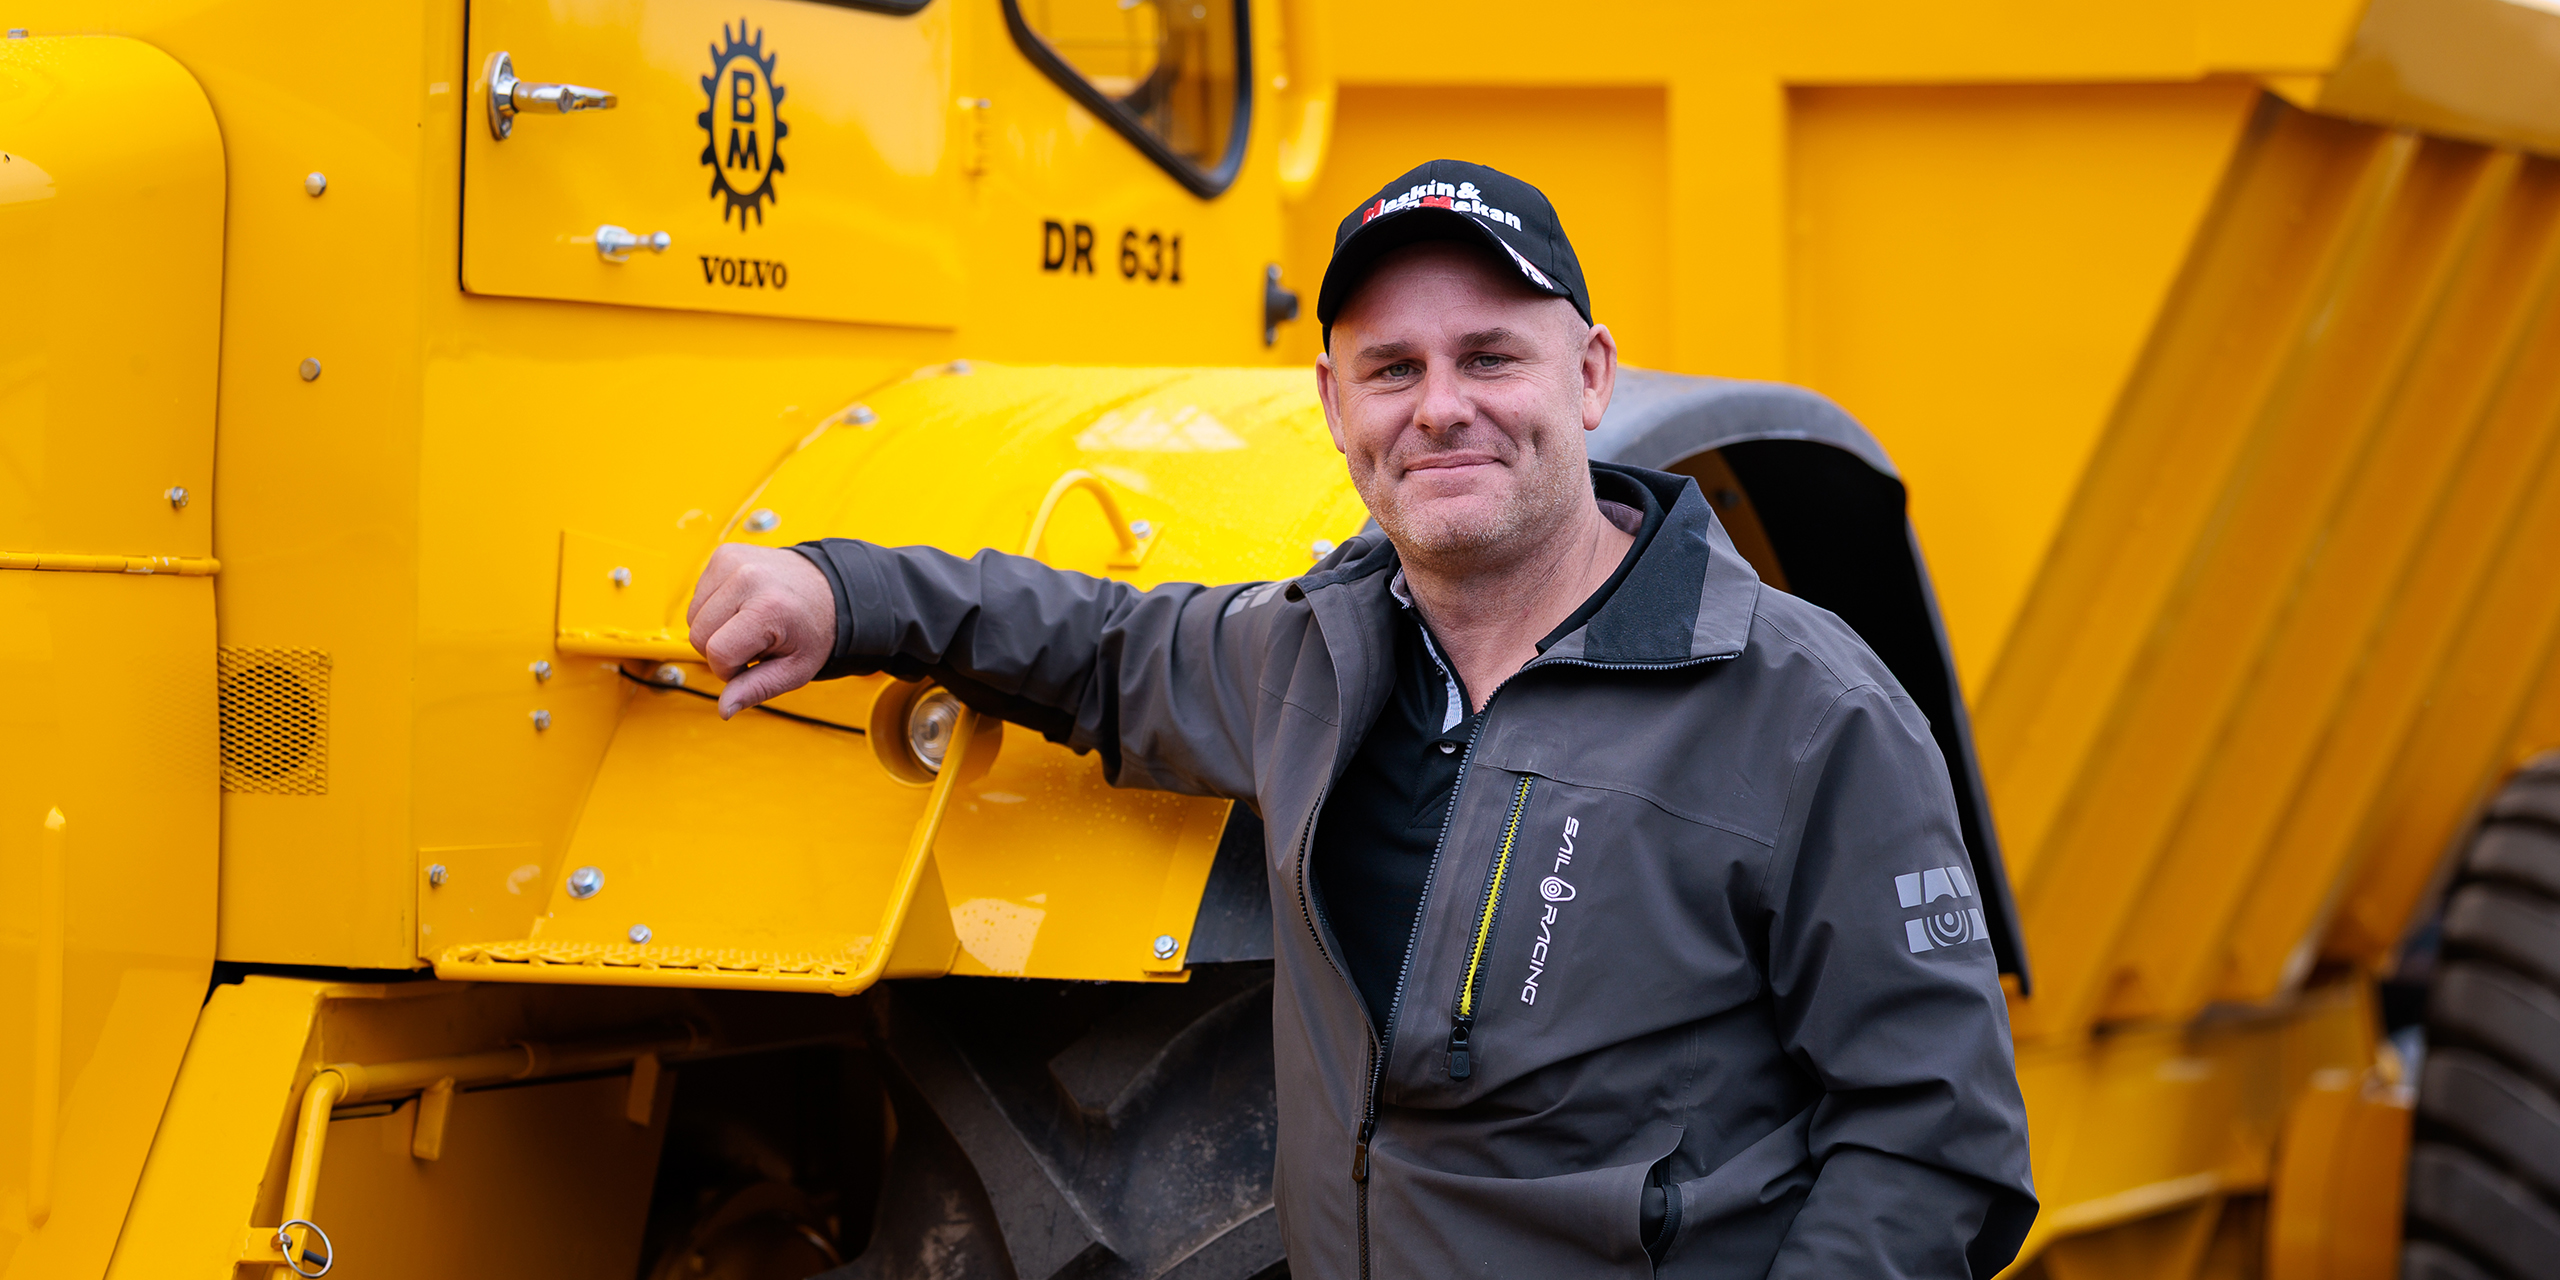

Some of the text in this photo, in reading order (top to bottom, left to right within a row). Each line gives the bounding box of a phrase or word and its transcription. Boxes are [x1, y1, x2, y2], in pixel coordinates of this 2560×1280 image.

[699, 255, 787, 290] VOLVO
[1041, 219, 1183, 285] DR 631
[1520, 815, 1580, 1006] SAIL RACING
